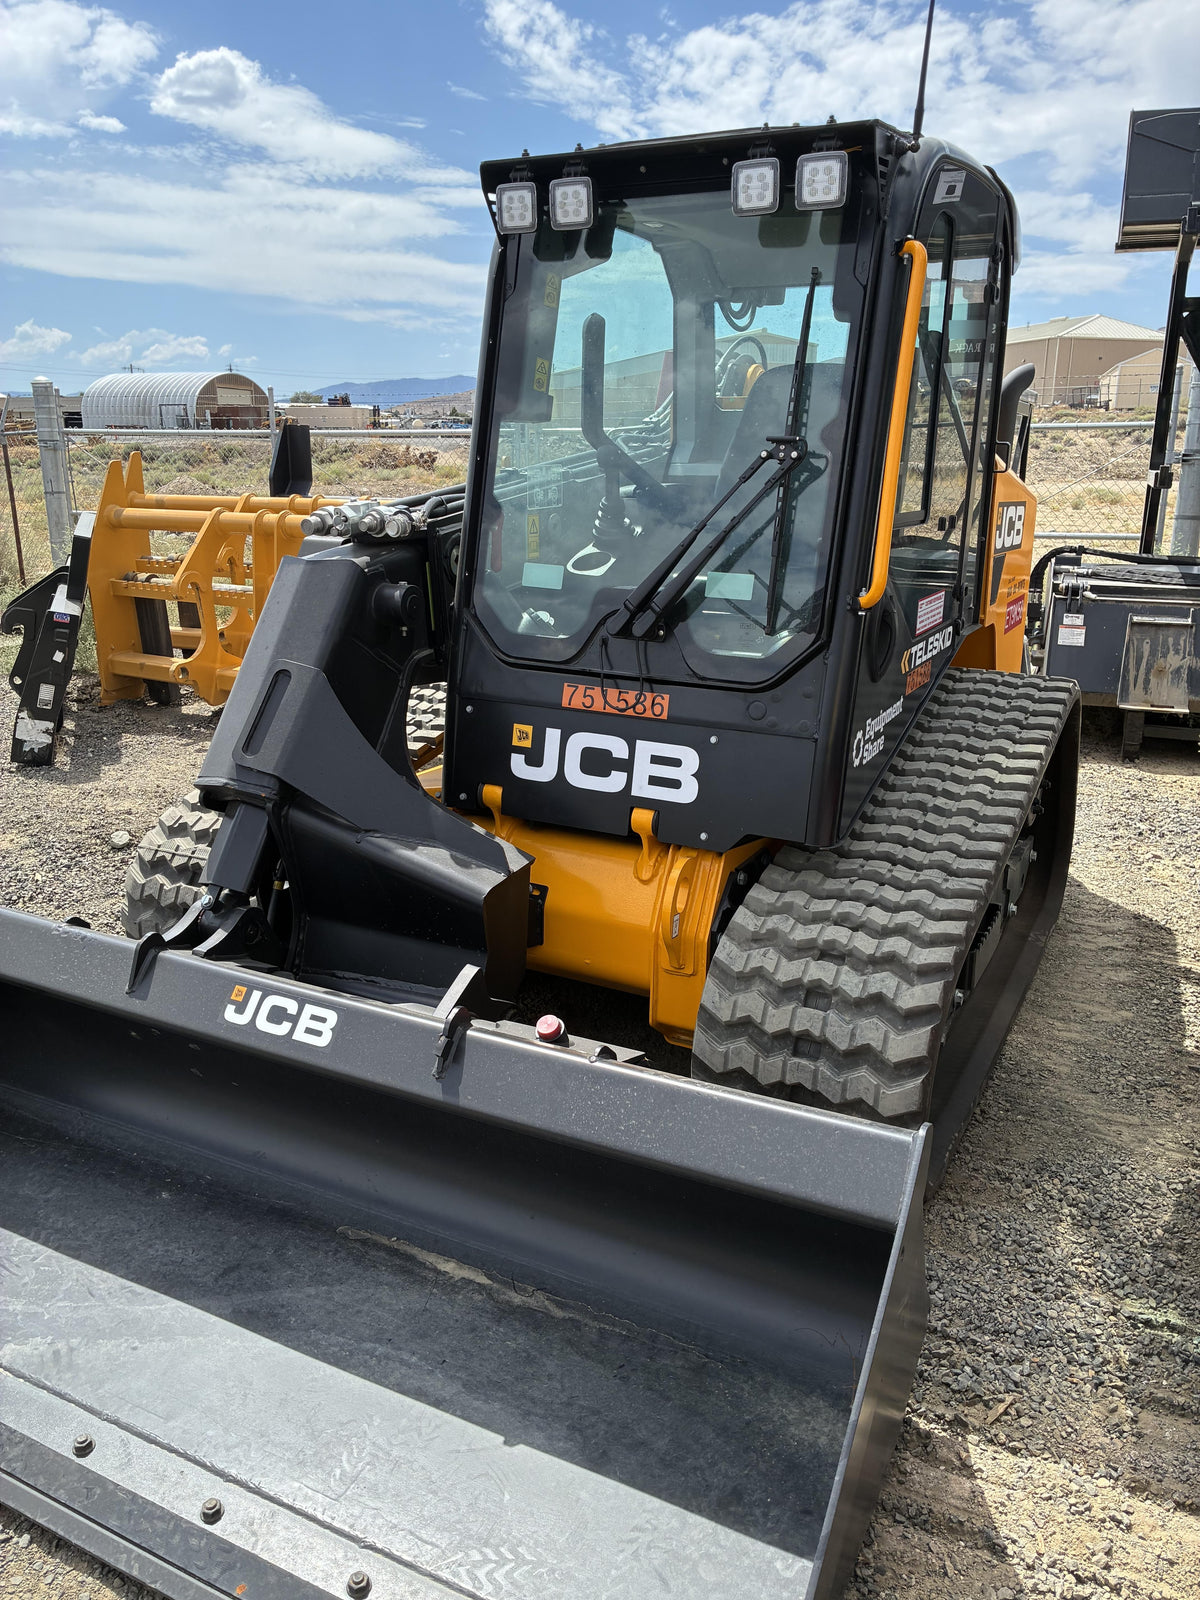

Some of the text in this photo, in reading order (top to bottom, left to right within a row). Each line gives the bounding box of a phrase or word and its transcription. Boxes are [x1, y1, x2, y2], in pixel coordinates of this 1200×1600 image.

[996, 506, 1025, 549] JCB
[911, 625, 953, 669] TELESKID
[566, 684, 665, 717] 751586
[865, 695, 904, 740] Equipment
[510, 727, 700, 804] JCB
[862, 735, 885, 765] Share
[223, 989, 338, 1048] JCB
